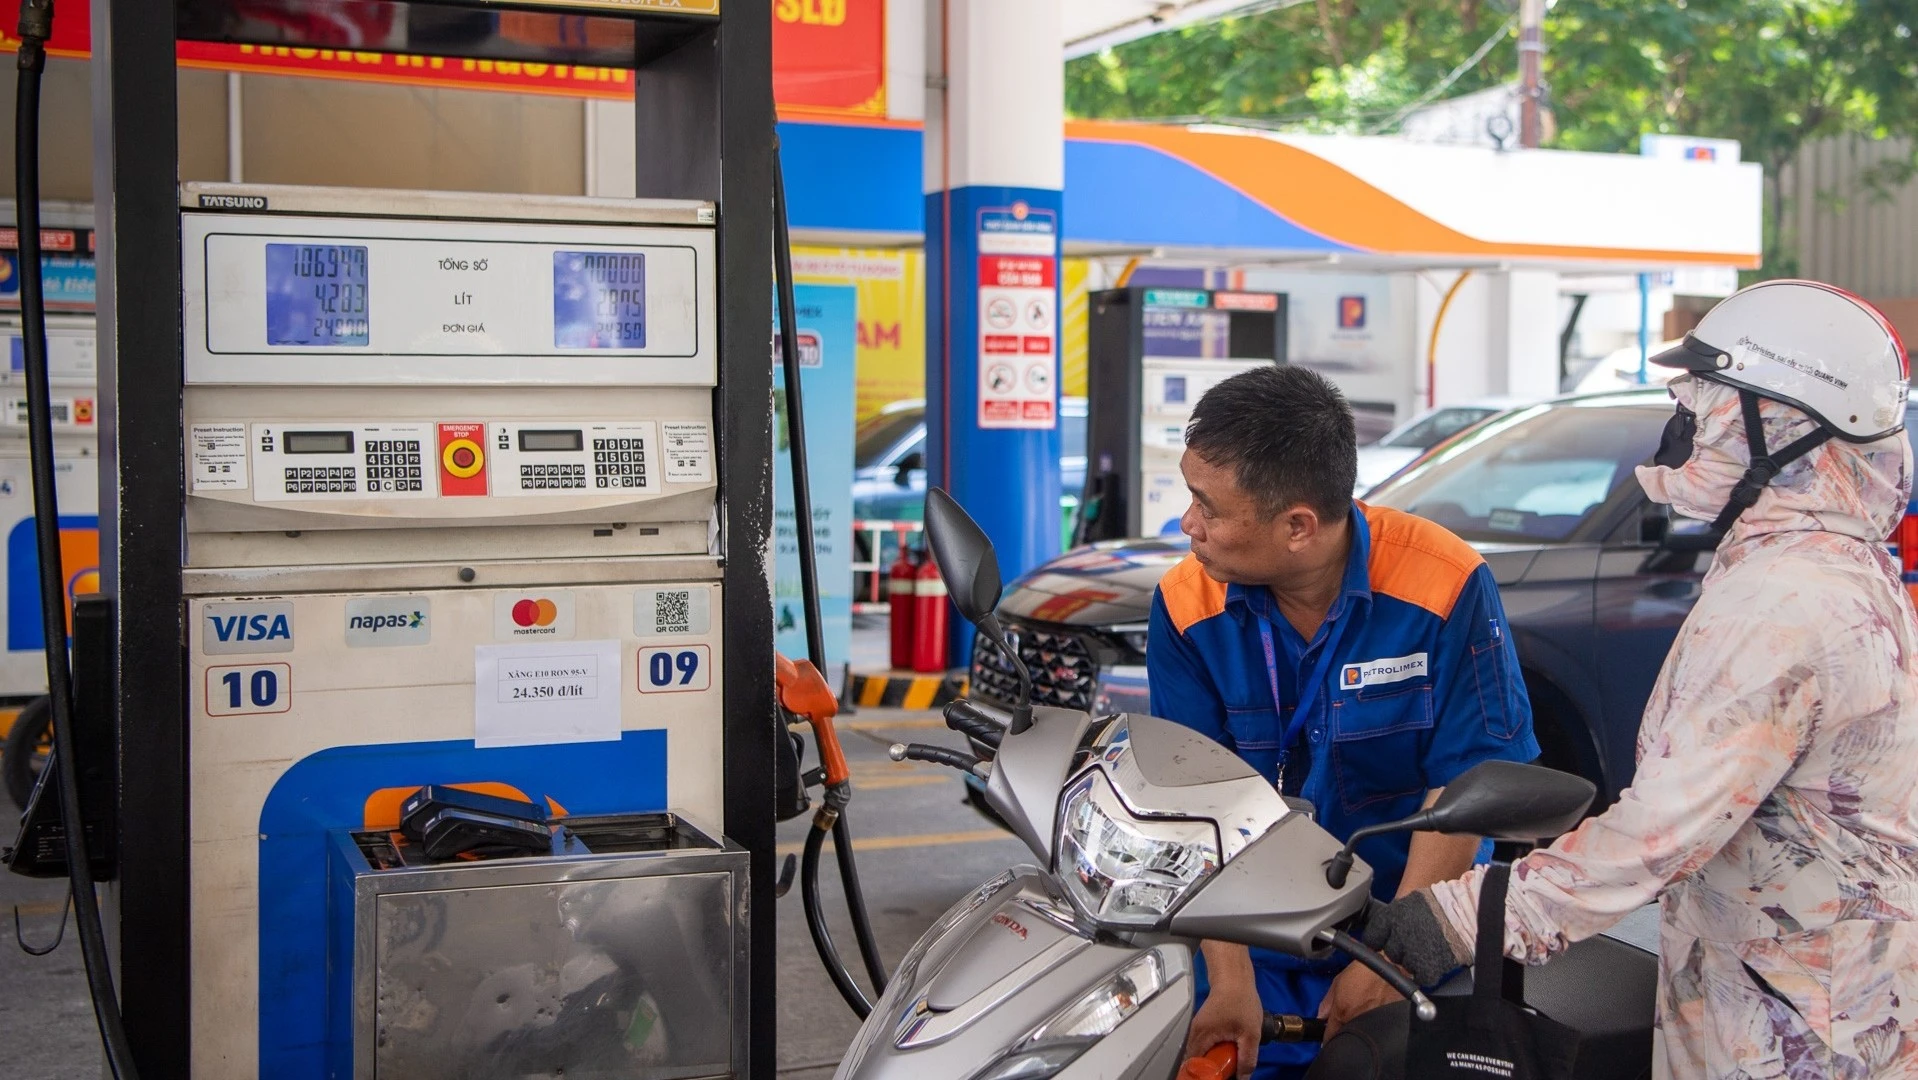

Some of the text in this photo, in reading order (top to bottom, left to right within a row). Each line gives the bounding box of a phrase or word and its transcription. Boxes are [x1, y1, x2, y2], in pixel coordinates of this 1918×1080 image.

[202, 196, 264, 208] TATSUNO
[294, 248, 365, 277] 106947
[438, 258, 488, 271] TỔNG SỐ
[454, 291, 472, 305] LÍT
[443, 322, 486, 333] ĐƠN GIÁ
[1752, 343, 1776, 360] Driving
[1814, 369, 1834, 383] QUANG
[1834, 378, 1848, 390] VINH
[368, 442, 375, 452] 7
[382, 442, 390, 452] 8
[396, 442, 404, 451] 9
[596, 440, 602, 450] 7
[608, 440, 616, 449] 8
[622, 440, 628, 449] 9
[369, 455, 376, 464] 4
[383, 455, 390, 464] 5
[396, 455, 404, 464] 6
[597, 452, 604, 462] 4
[610, 453, 616, 462] 5
[622, 452, 630, 462] 6
[370, 468, 376, 478] 1
[384, 468, 390, 478] 2
[398, 468, 404, 478] 3
[598, 466, 604, 474] 1
[610, 466, 618, 474] 2
[624, 466, 630, 474] 3
[287, 483, 298, 491] P6
[330, 482, 340, 490] P9
[370, 482, 378, 490] 0
[384, 482, 392, 490] C
[598, 478, 606, 487] 0
[612, 478, 618, 486] C
[207, 614, 290, 642] VISA
[350, 614, 407, 632] napas
[514, 627, 556, 635] mastercard
[650, 651, 698, 686] 09
[508, 670, 533, 678] XĂNG
[222, 670, 278, 708] 10
[513, 684, 584, 698] 24.350 đ/lít
[1470, 1054, 1484, 1063] READ
[1482, 1065, 1512, 1078] POSSIBLE
